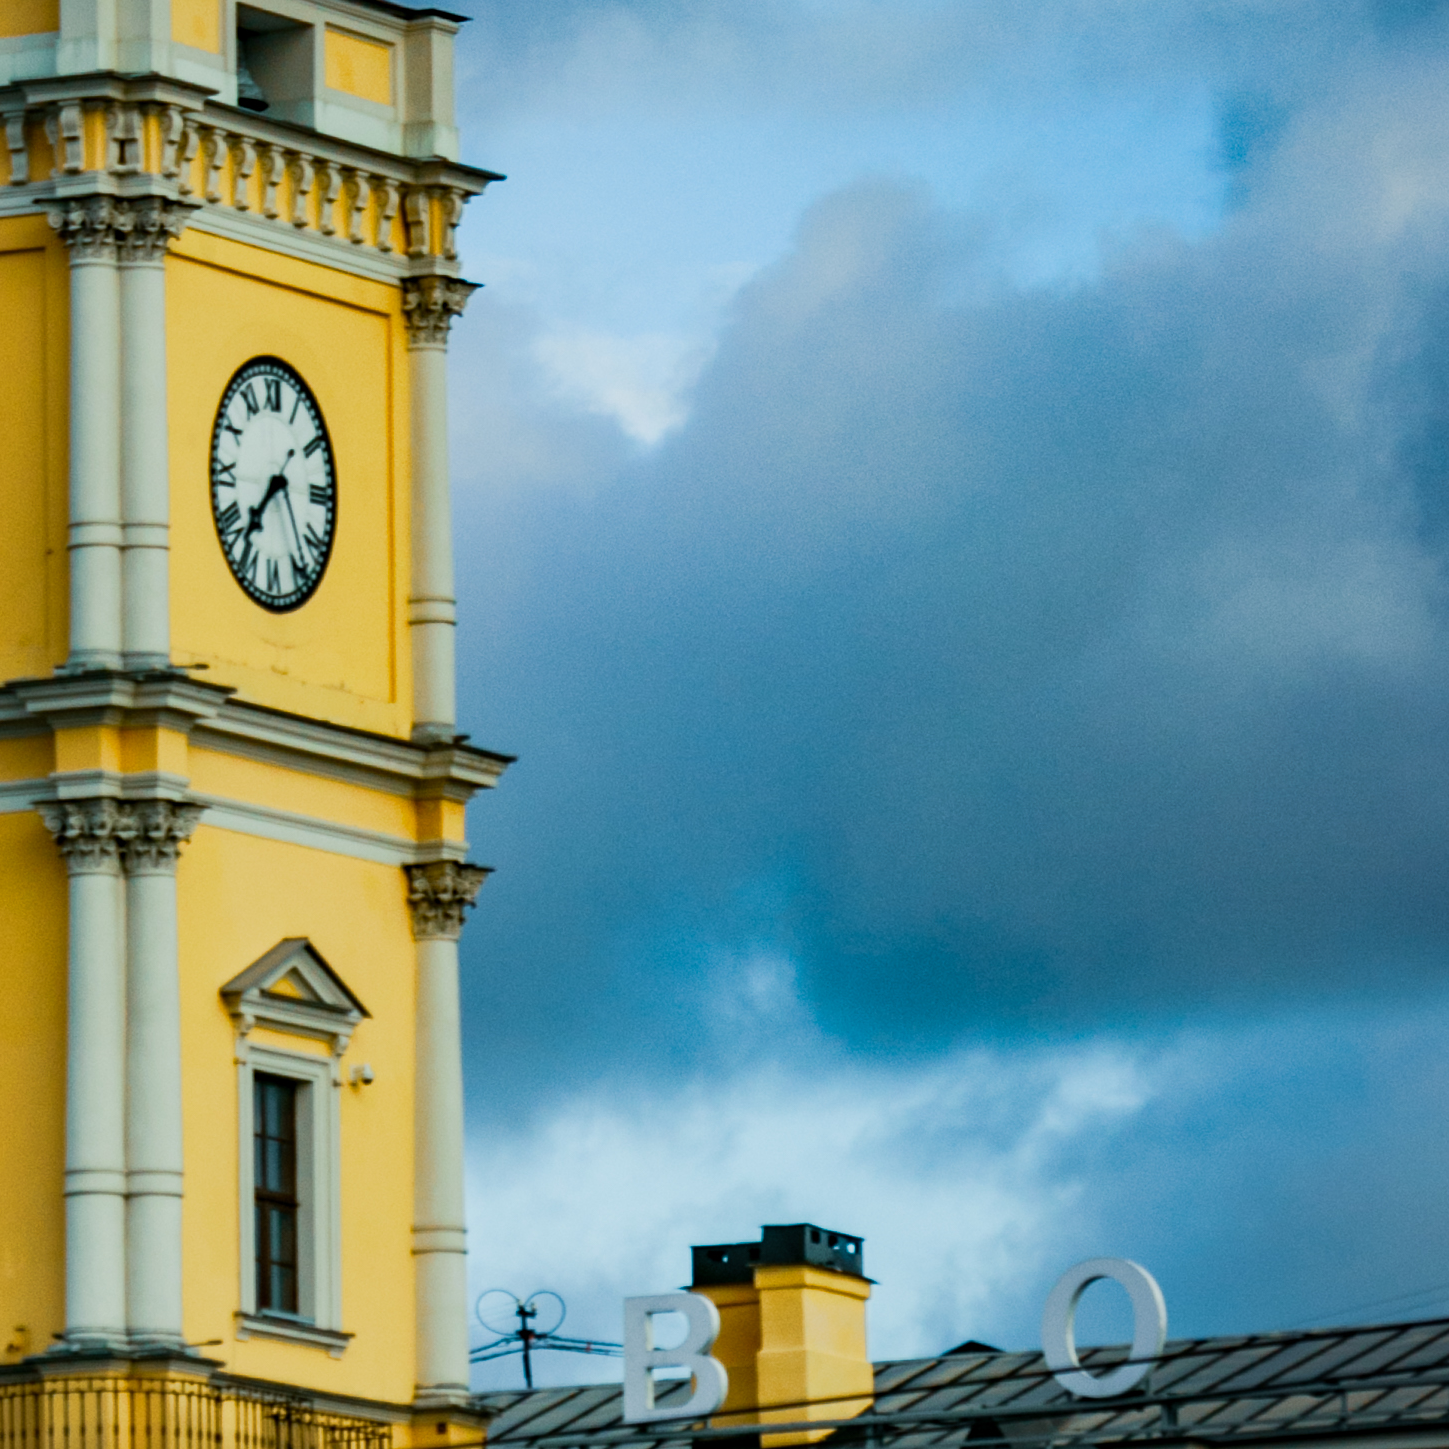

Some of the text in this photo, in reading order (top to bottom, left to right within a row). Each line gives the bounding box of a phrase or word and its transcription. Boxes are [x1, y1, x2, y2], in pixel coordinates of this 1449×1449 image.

[264, 378, 281, 413] XII
[289, 395, 300, 425] I
[225, 414, 243, 446] X
[303, 436, 321, 458] II
[218, 459, 236, 487] IX
[310, 484, 327, 507] III
[266, 558, 281, 595] VI
